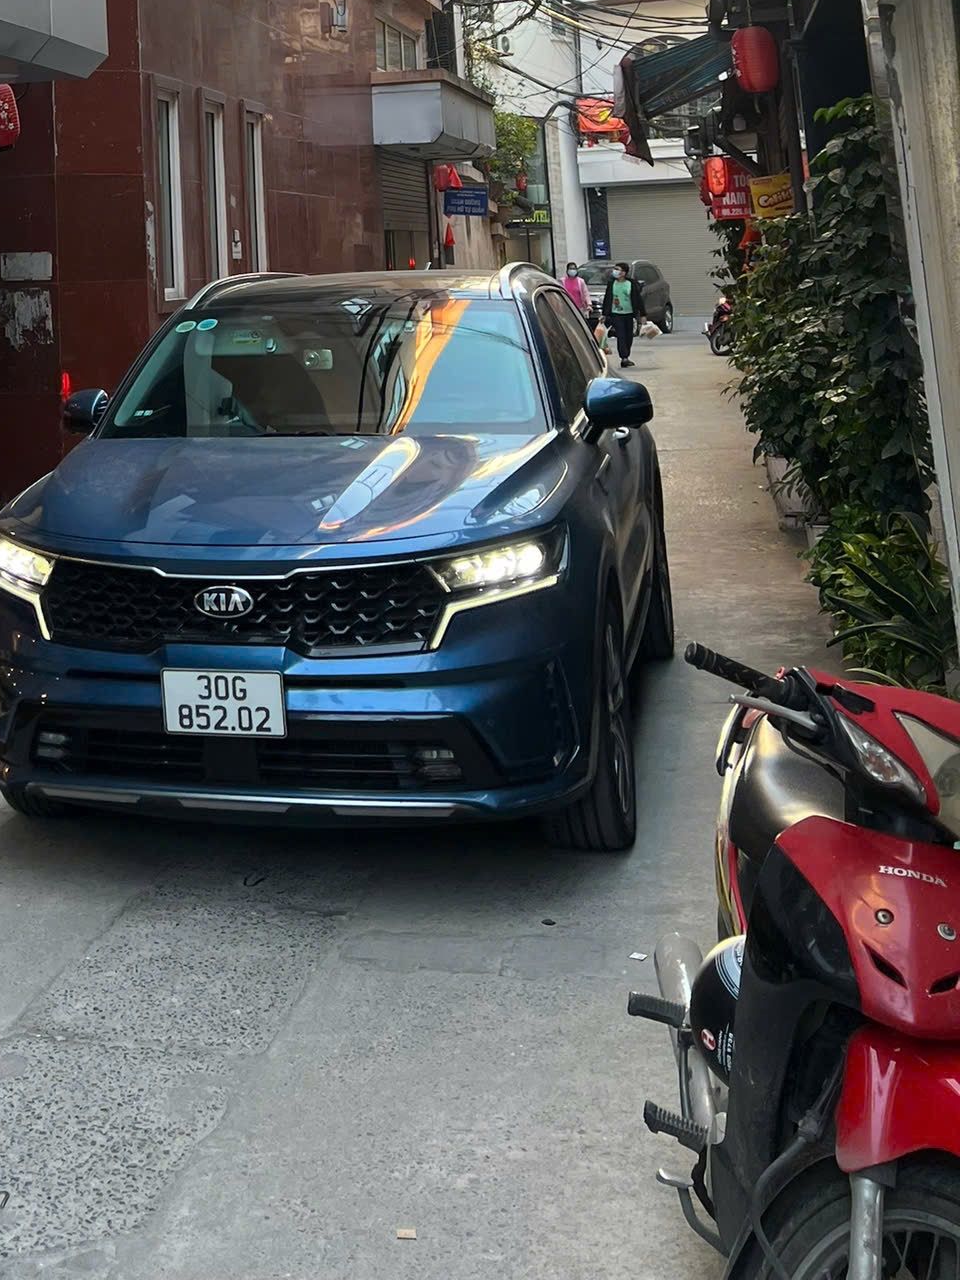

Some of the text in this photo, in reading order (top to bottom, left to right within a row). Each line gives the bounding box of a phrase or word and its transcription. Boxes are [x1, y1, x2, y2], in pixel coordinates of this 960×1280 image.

[203, 593, 245, 612] KIA
[197, 675, 247, 701] 30G
[178, 704, 272, 733] 852.02
[879, 865, 948, 888] HONDA
